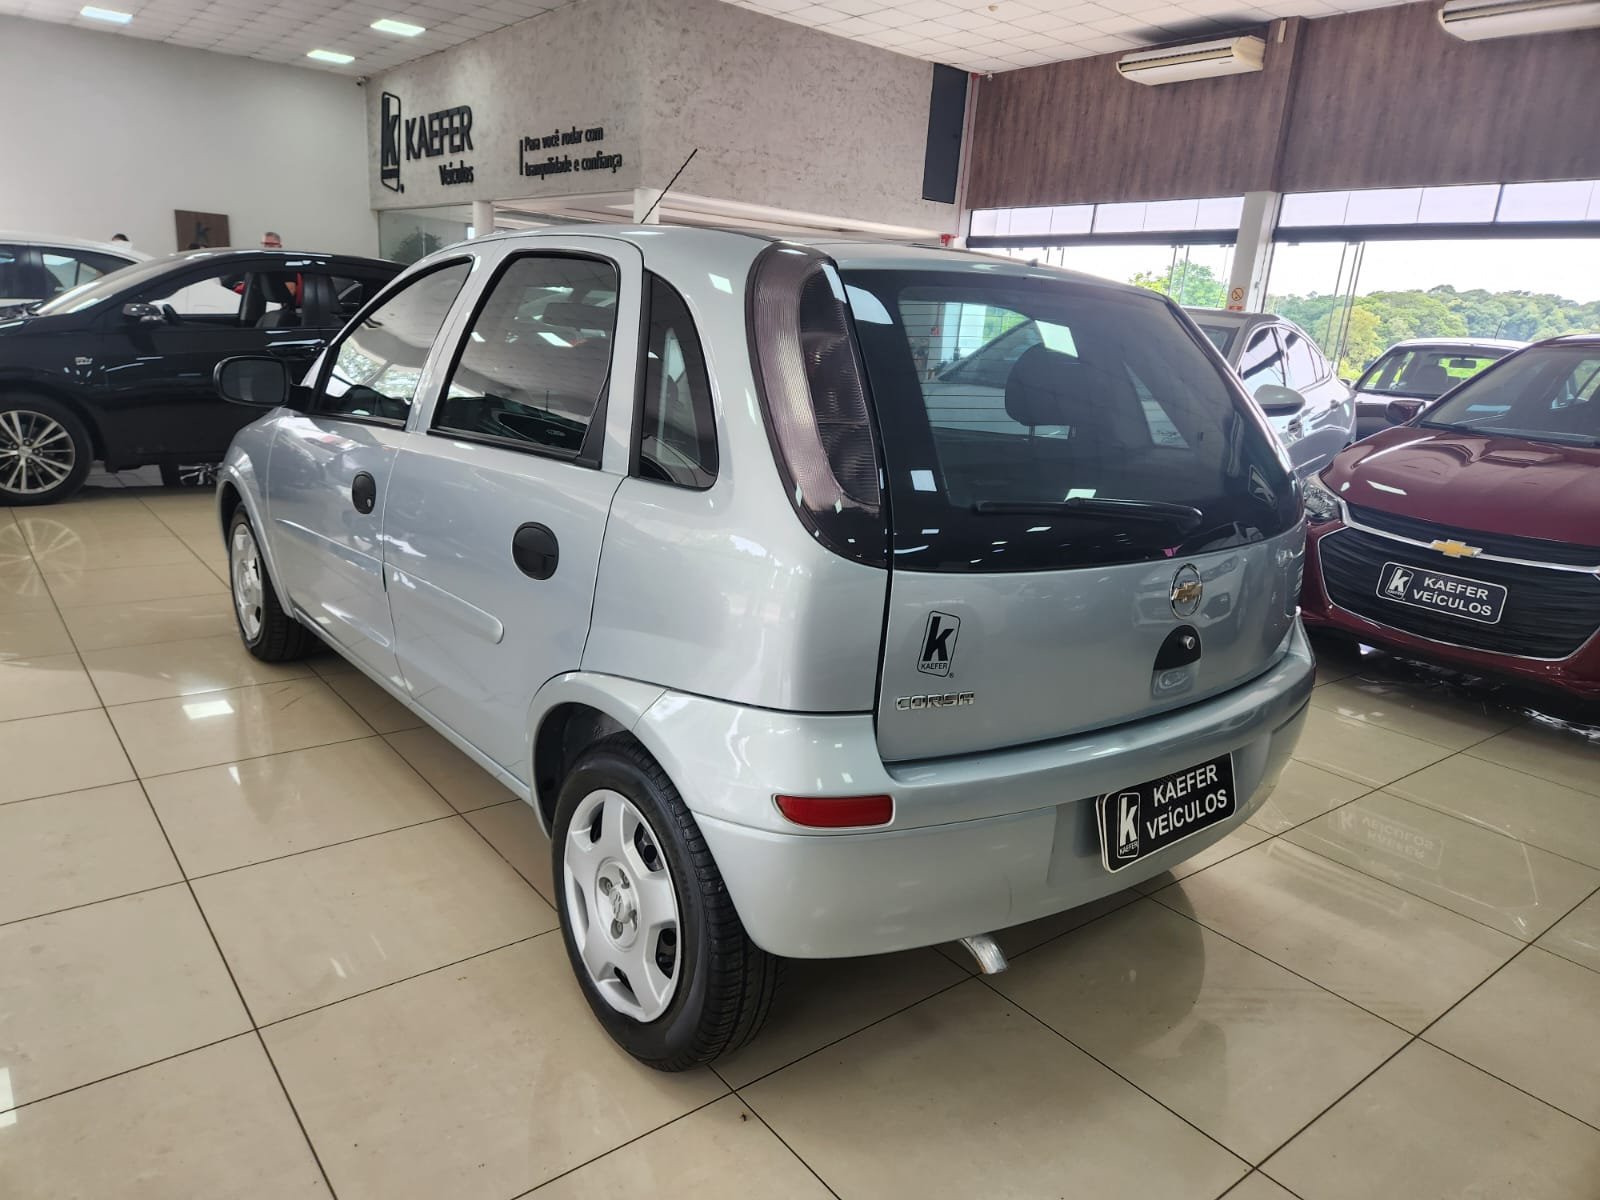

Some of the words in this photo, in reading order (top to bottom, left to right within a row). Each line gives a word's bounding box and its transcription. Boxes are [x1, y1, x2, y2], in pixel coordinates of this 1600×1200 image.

[405, 105, 473, 161] KAEFER
[524, 136, 540, 152] Para
[542, 129, 559, 149] você
[585, 127, 603, 142] com
[439, 160, 474, 186] Veículos
[574, 159, 580, 172] e
[581, 150, 622, 173] confiança
[1423, 577, 1489, 600] KAEFER
[1413, 589, 1492, 616] VEÍCULOS
[920, 662, 948, 670] KAEFER
[896, 691, 975, 711] CORSA
[1153, 764, 1218, 807] KAEFER
[1146, 789, 1228, 839] VEÍCULOS
